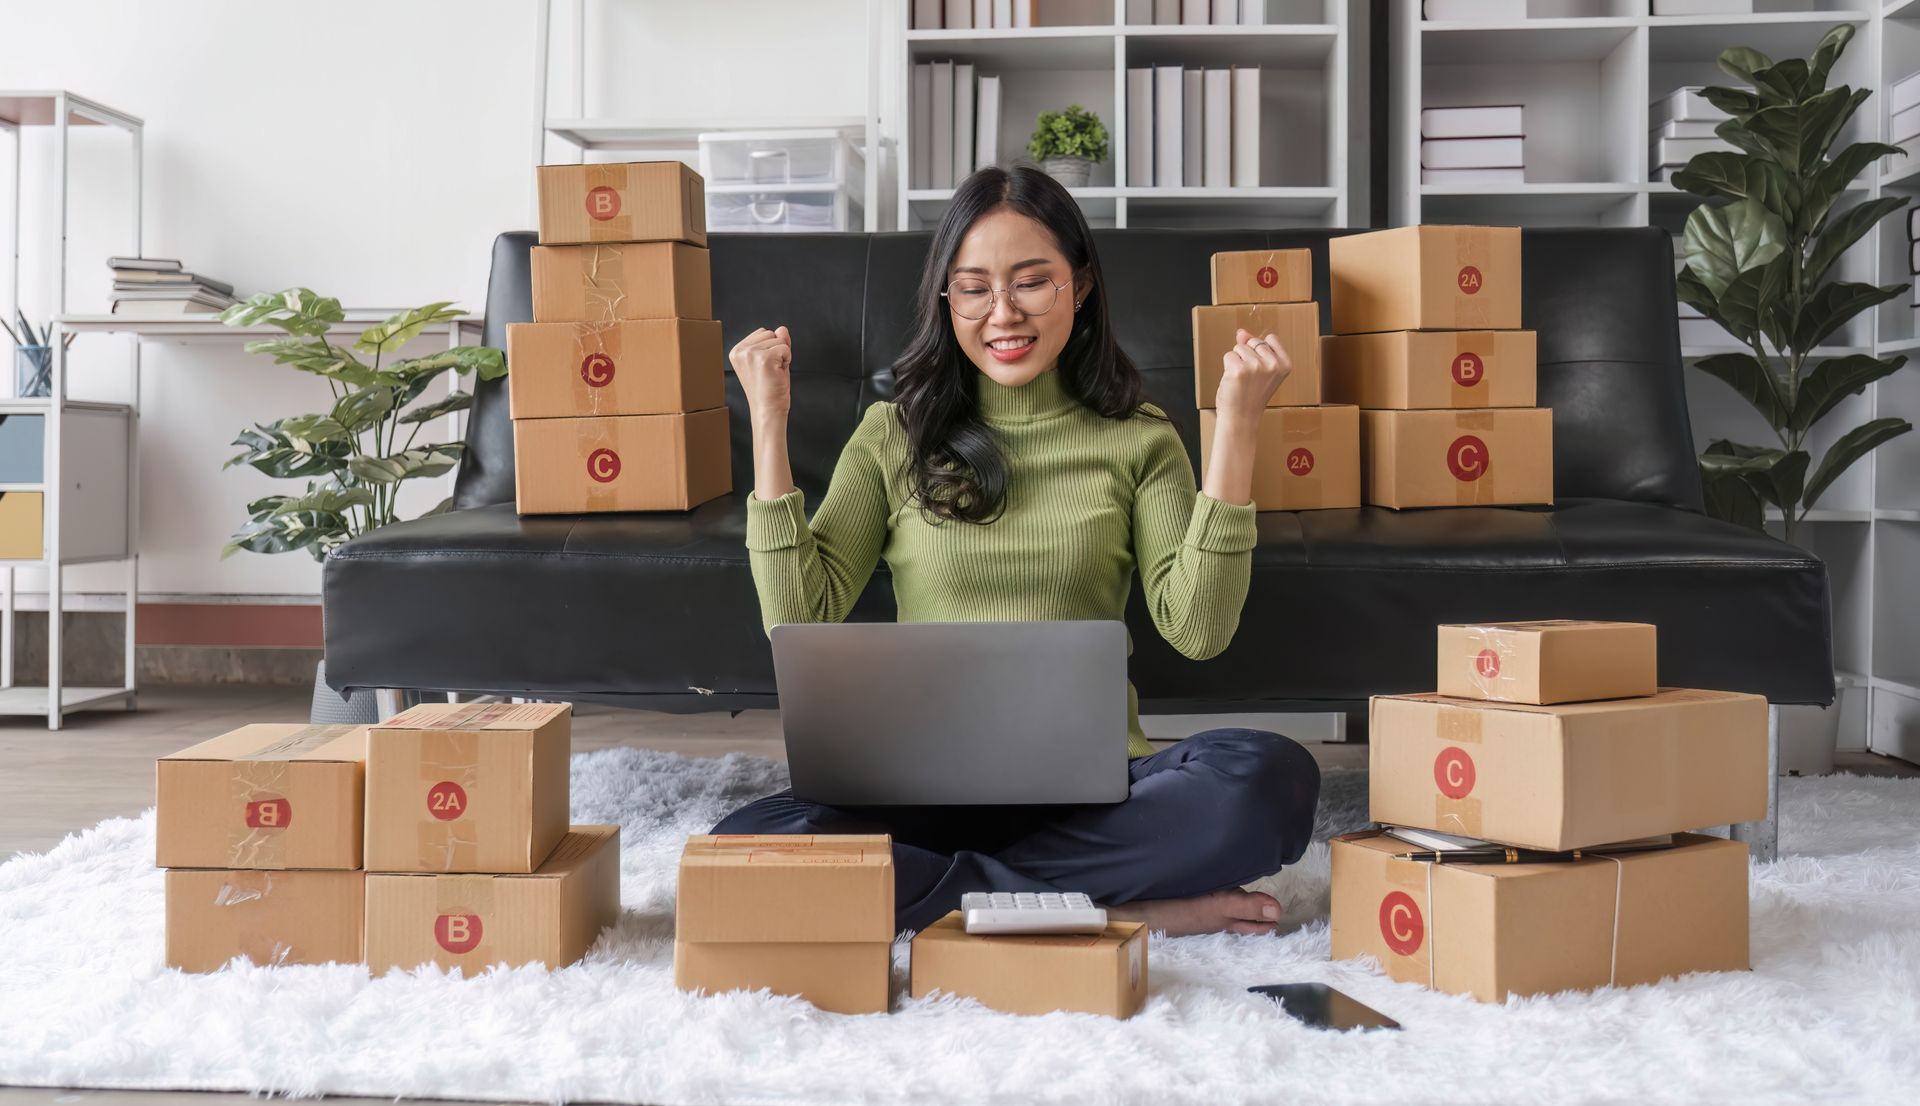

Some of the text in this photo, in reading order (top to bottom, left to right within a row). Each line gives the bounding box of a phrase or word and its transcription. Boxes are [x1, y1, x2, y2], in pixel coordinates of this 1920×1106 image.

[596, 195, 612, 213] B
[1461, 274, 1479, 287] 2A
[589, 360, 607, 383] C
[1461, 360, 1476, 379] B
[595, 455, 613, 478] C
[1291, 456, 1311, 469] 2A
[1459, 445, 1478, 473] C
[1447, 760, 1464, 787] C
[433, 793, 461, 811] 2A
[258, 804, 278, 825] B
[449, 916, 471, 942] B
[1392, 904, 1413, 942] C
